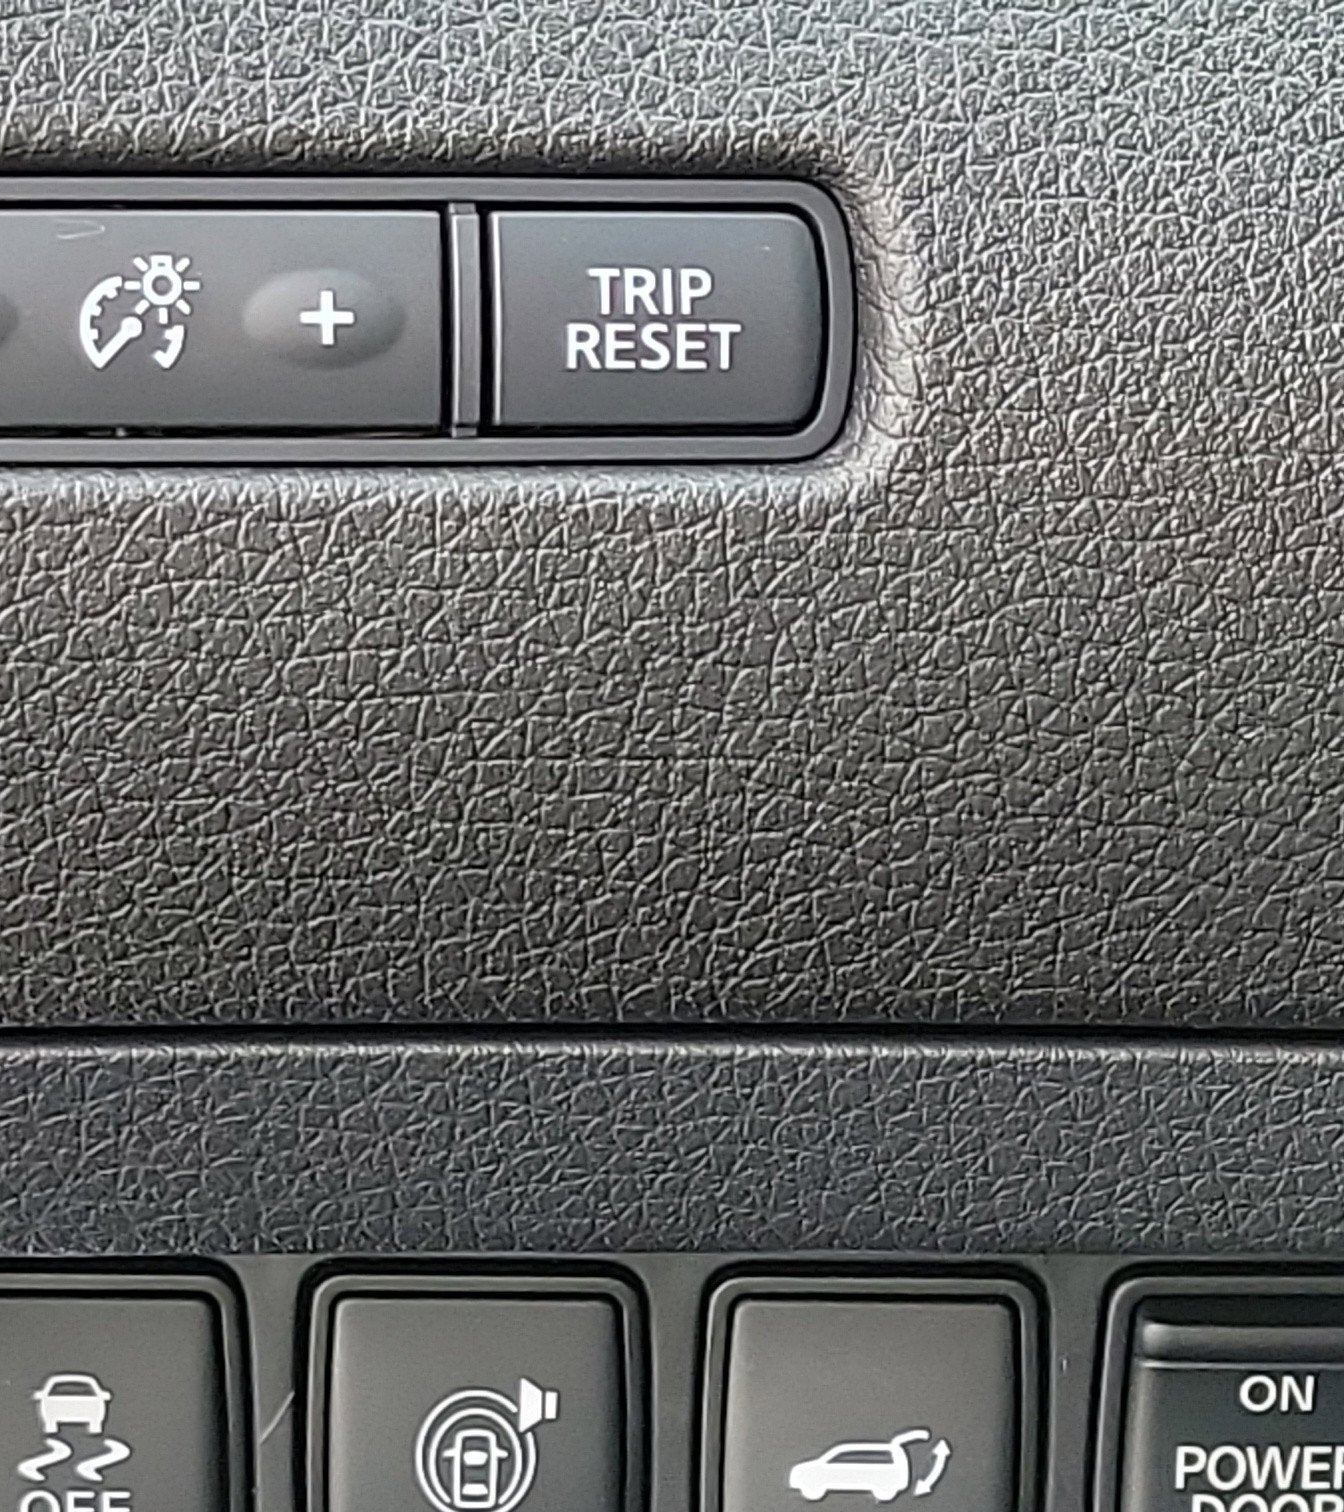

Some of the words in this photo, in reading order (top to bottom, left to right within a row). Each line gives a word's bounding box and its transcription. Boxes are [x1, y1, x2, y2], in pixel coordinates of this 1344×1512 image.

[587, 267, 712, 316] TRIP
[566, 322, 742, 370] RESET
[1239, 1375, 1315, 1412] ON
